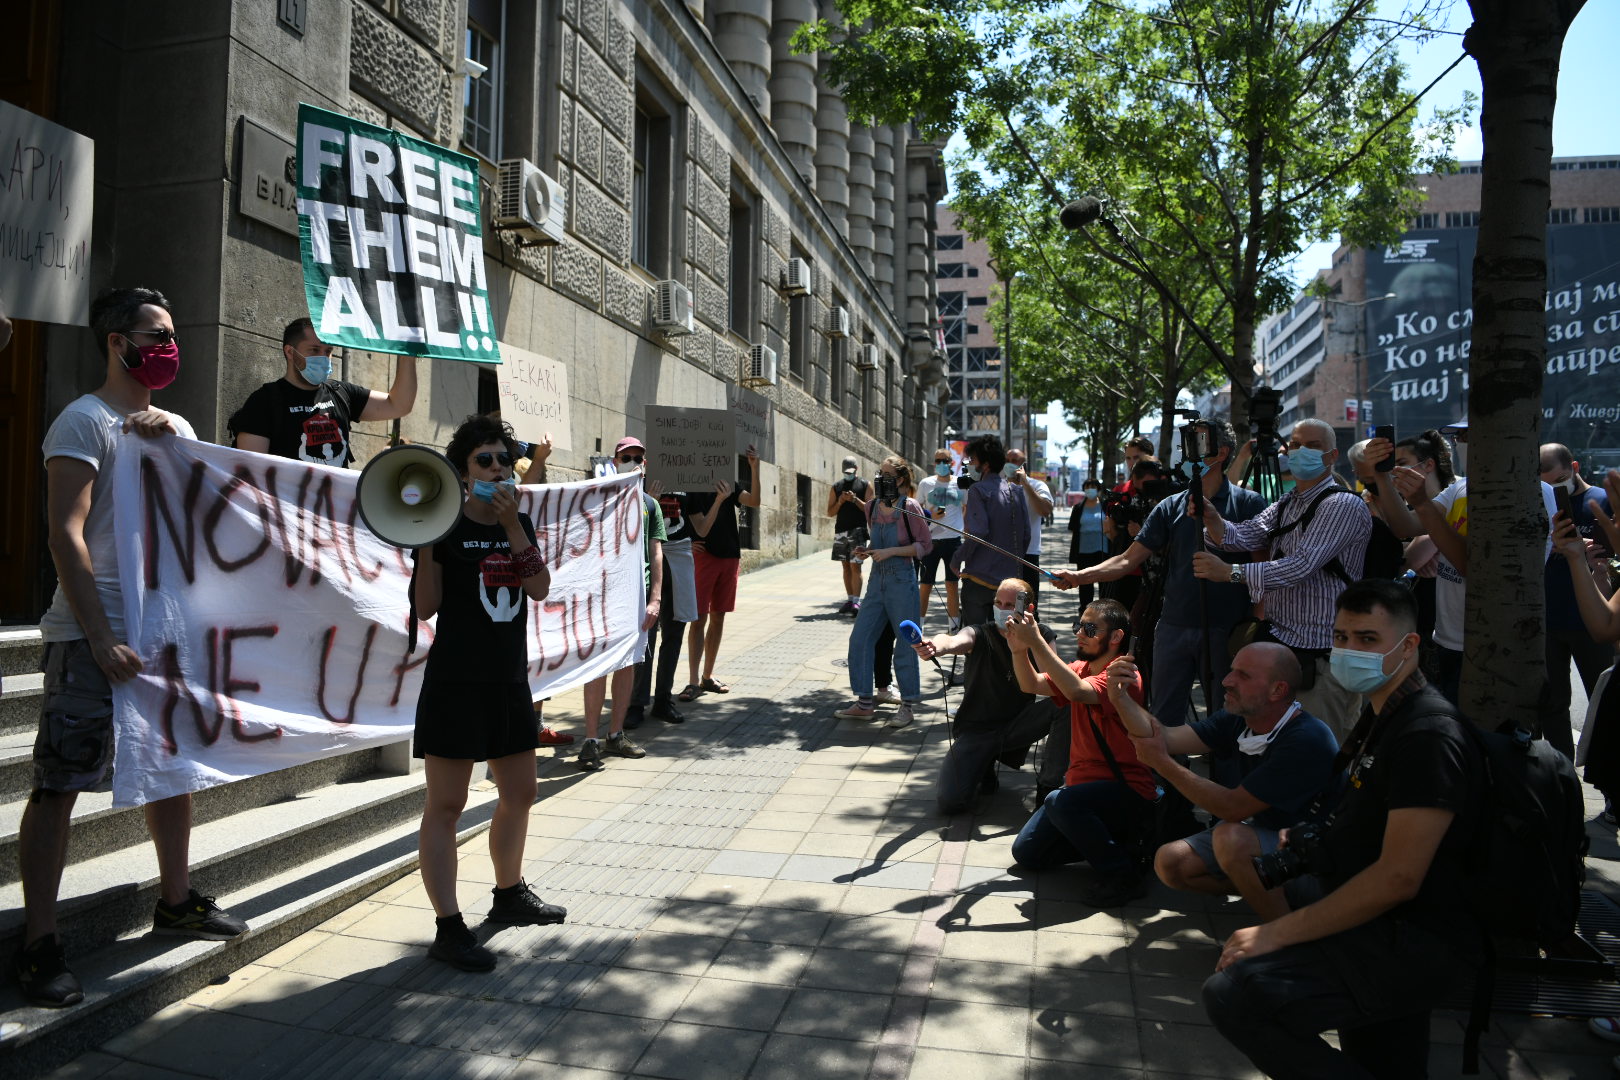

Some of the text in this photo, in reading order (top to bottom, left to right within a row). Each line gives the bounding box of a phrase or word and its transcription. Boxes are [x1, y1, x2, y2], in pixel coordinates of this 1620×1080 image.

[0, 138, 69, 220] АРИ,
[302, 121, 477, 227] FREE
[296, 197, 488, 291] THEM
[320, 275, 494, 352] ALL!!
[1384, 344, 1428, 373] Ко
[1547, 319, 1583, 343] за
[659, 452, 731, 468] PANDURI ŠETAJU
[661, 436, 686, 447] RANIJE
[159, 626, 282, 756] NE
[318, 623, 376, 724] U
